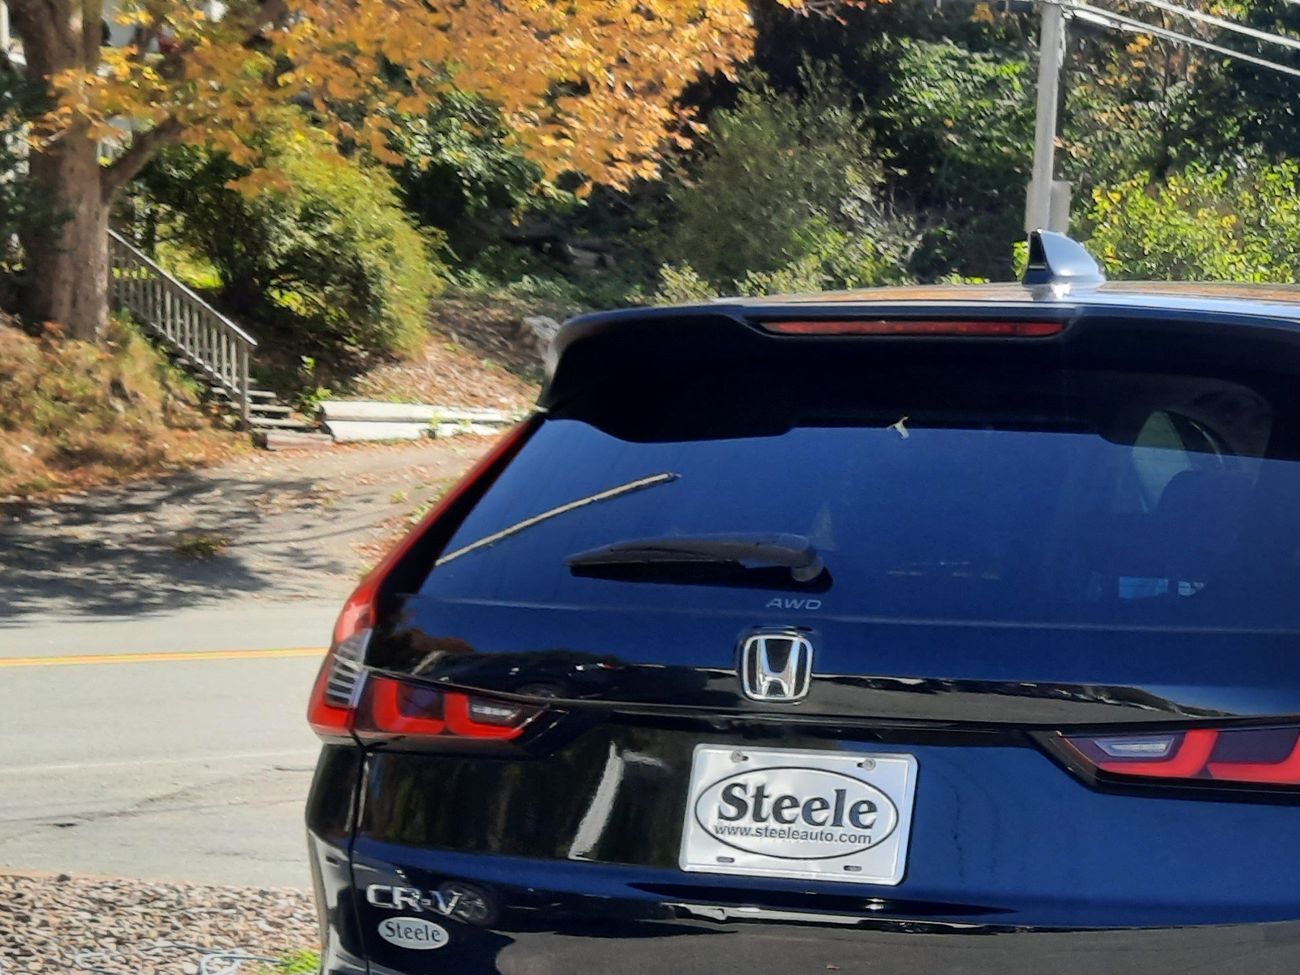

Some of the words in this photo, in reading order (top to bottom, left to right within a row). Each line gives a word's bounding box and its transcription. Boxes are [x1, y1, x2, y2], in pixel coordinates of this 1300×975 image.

[765, 598, 822, 610] AWD
[718, 782, 878, 830] Steele
[714, 825, 872, 845] www.steeleauto.com
[366, 884, 463, 916] CR-V
[385, 921, 441, 943] Steele
